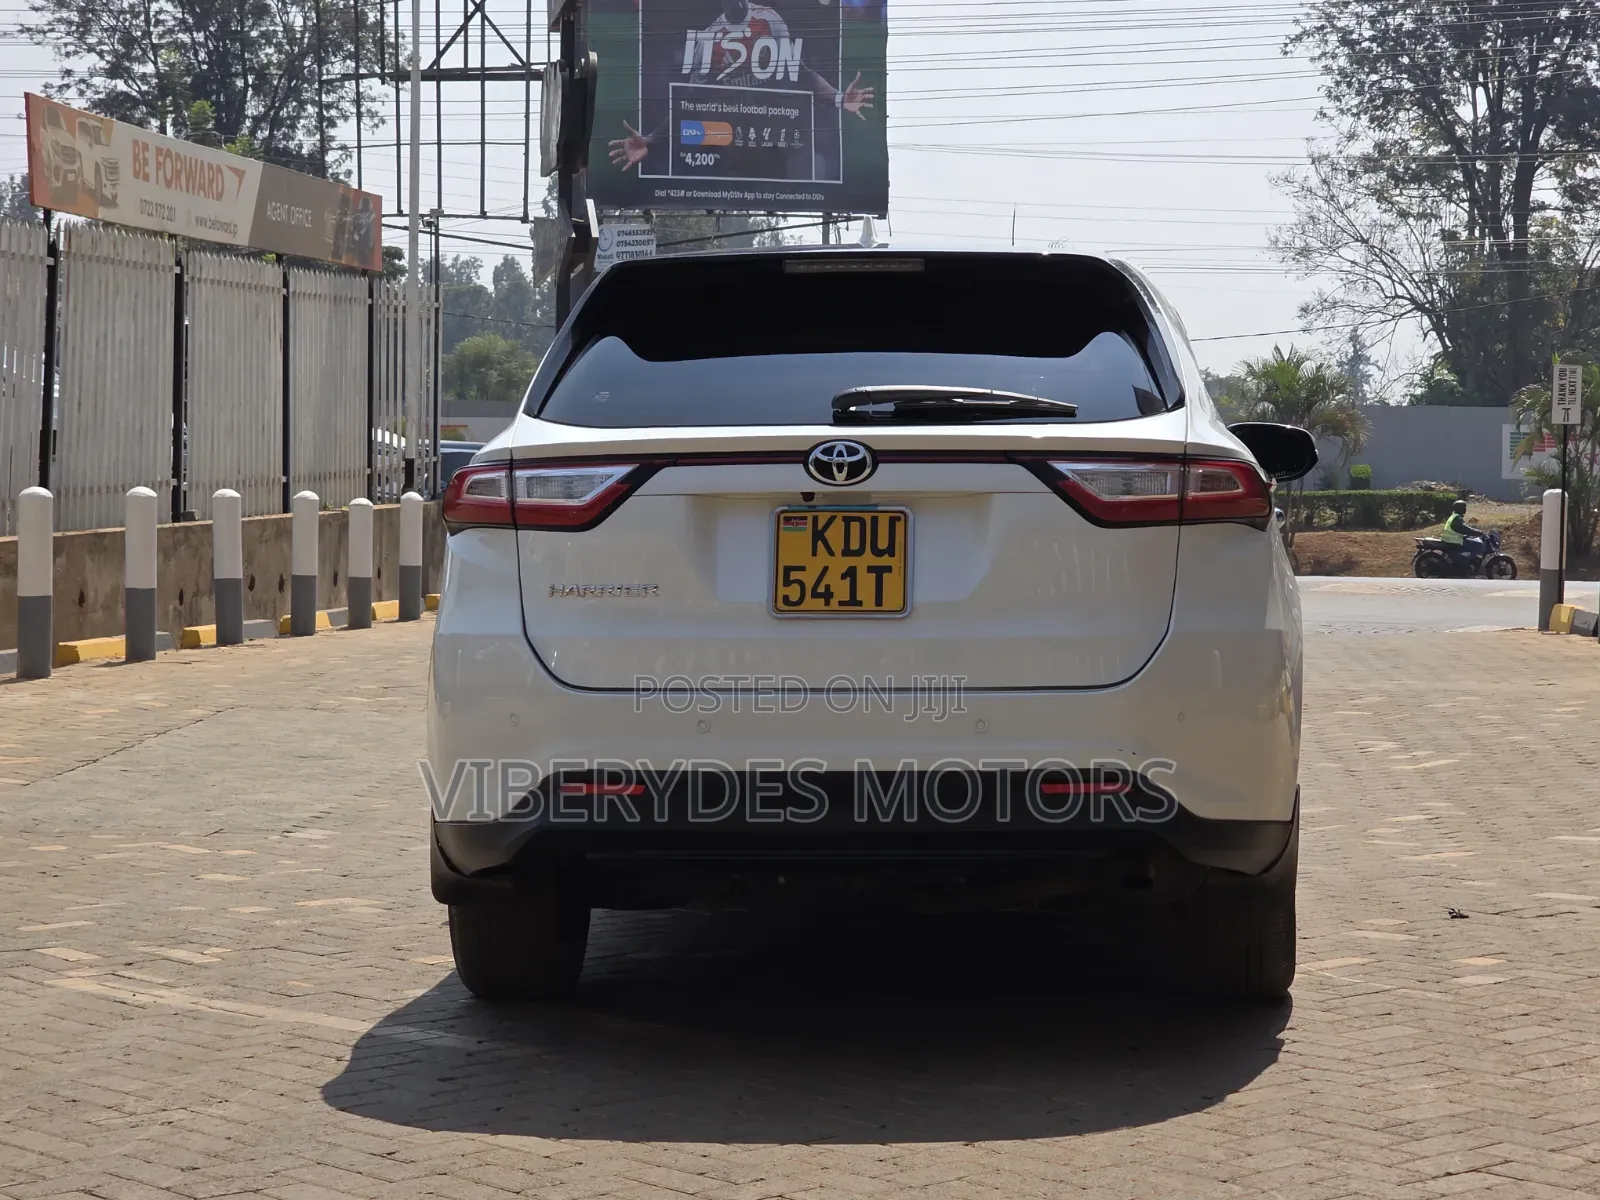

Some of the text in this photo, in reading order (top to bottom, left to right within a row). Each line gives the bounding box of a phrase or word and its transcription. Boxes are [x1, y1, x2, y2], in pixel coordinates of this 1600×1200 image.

[682, 29, 803, 82] IT'S ON
[680, 100, 800, 119] The world's best football package
[132, 138, 225, 202] BE FORWARD
[685, 152, 715, 167] 4,200
[654, 188, 667, 198] Dial
[685, 190, 693, 198] or
[693, 189, 722, 199] Download
[744, 191, 756, 201] App
[756, 191, 763, 200] to
[763, 191, 775, 202] stay
[775, 192, 805, 201] Connected
[805, 192, 812, 201] to
[266, 201, 313, 228] AGENT OFFICE
[1558, 367, 1567, 406] THANK YOU
[1568, 380, 1577, 396] NEXT
[811, 515, 902, 557] KDU
[549, 583, 660, 598] HARRIER
[782, 565, 893, 607] 541T
